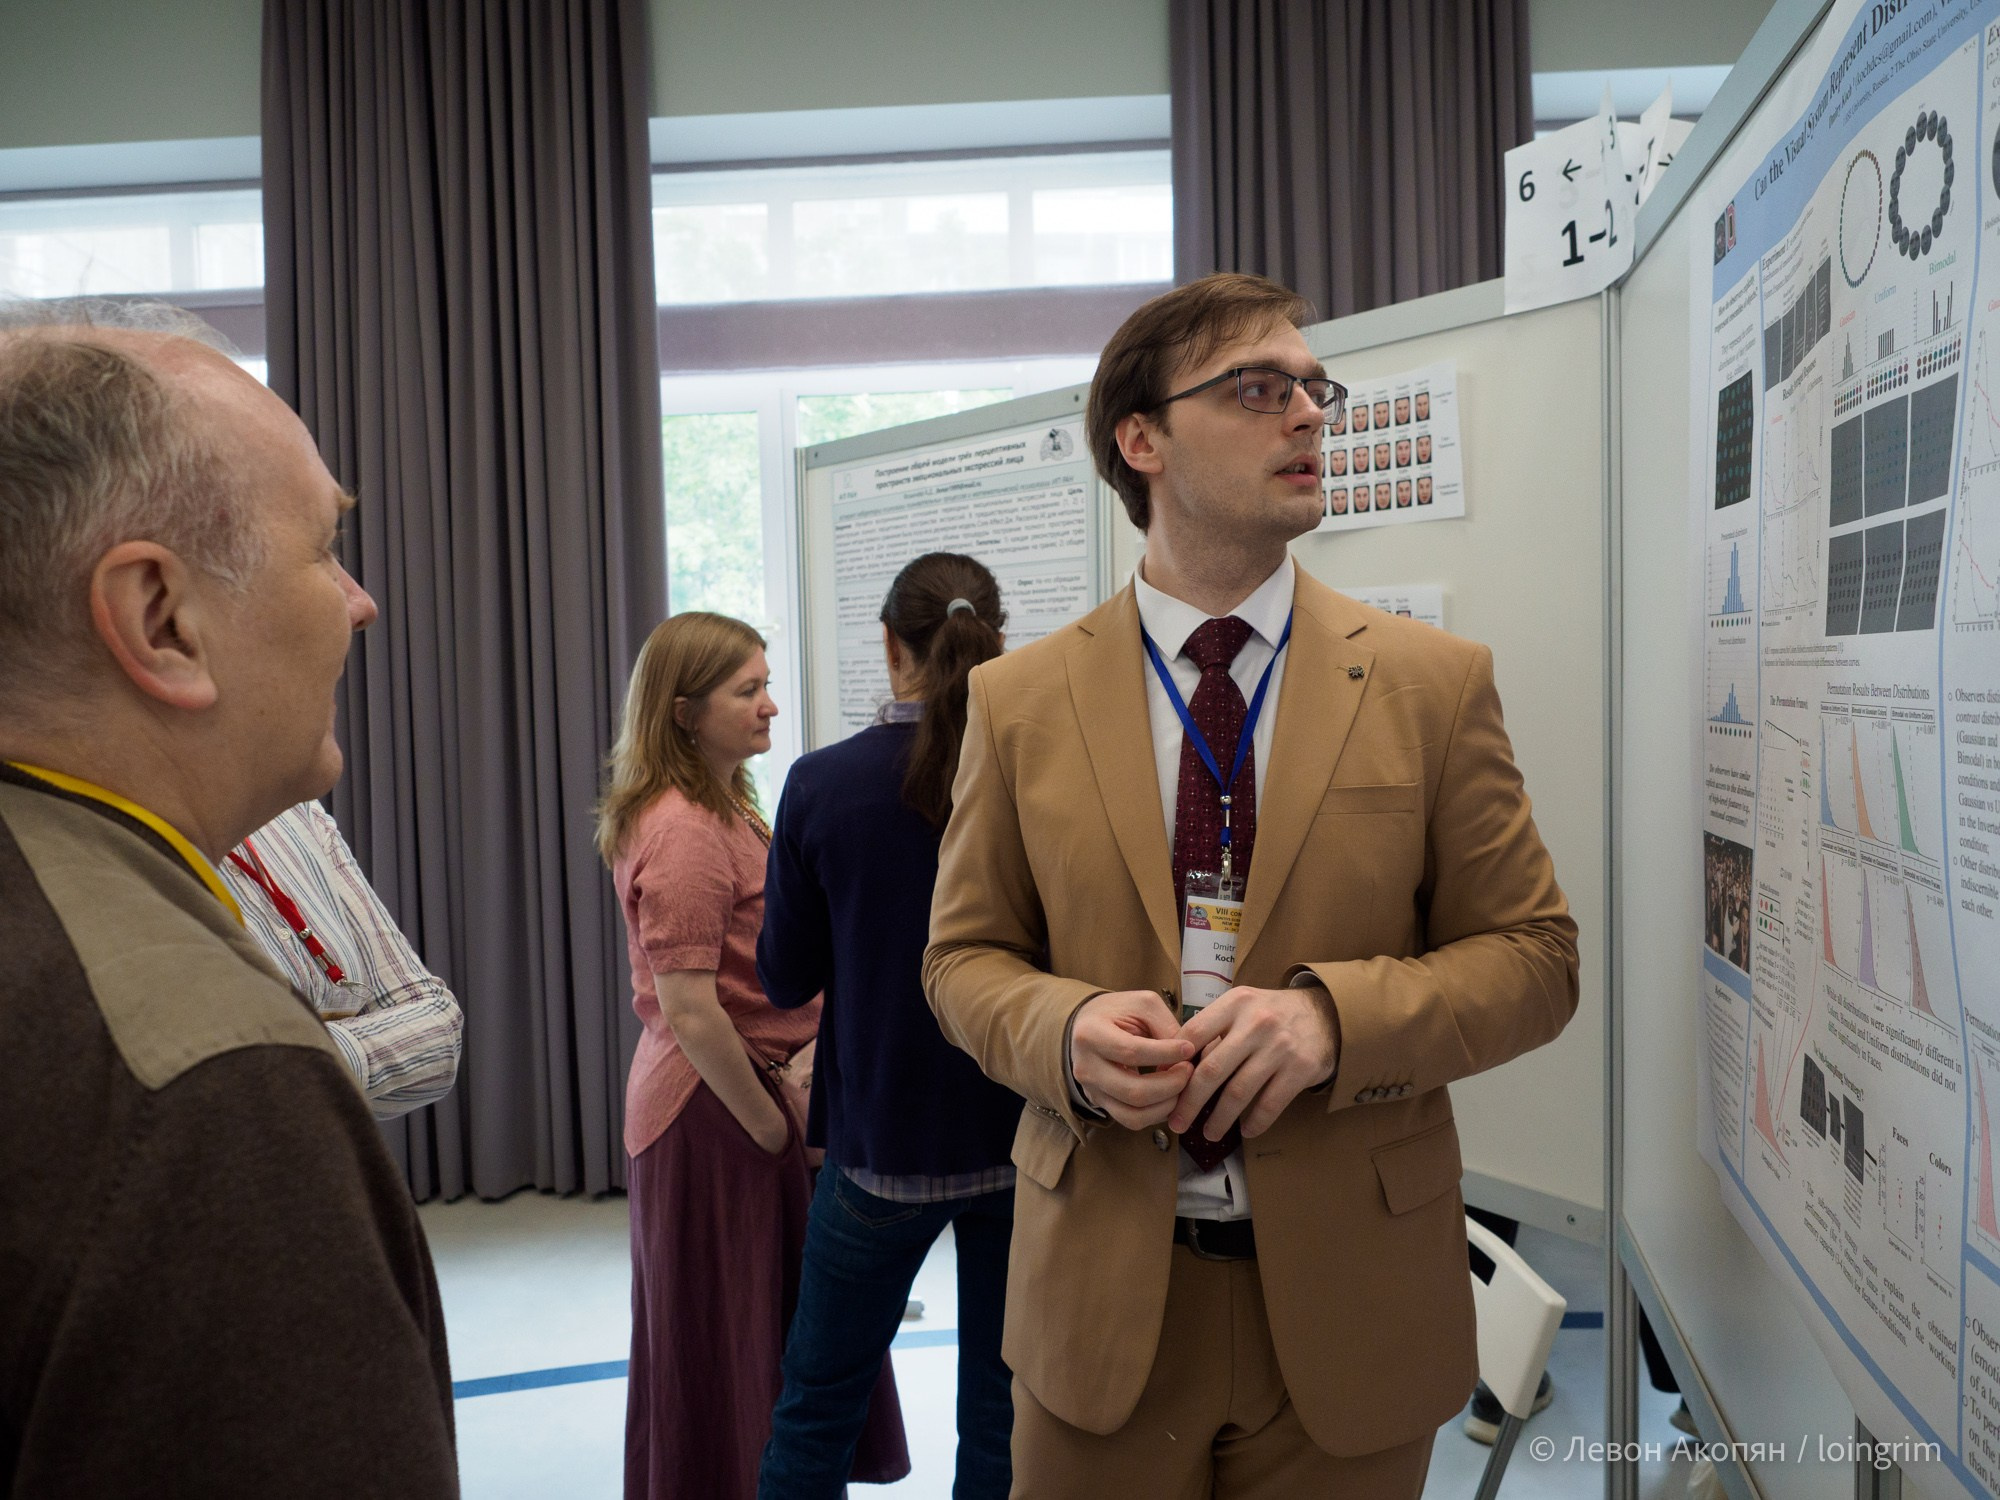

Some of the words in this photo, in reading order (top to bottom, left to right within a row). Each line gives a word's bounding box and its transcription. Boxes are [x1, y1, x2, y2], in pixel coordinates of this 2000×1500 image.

[1906, 44, 1922, 64] Ohio
[1922, 34, 1937, 52] State
[1769, 156, 1784, 184] the
[1784, 128, 1807, 166] Visual
[1806, 92, 1830, 140] System
[1830, 19, 1868, 96] Represent
[1519, 170, 1536, 202] 6
[1561, 199, 1618, 268] 1-2
[1929, 250, 1957, 275] Bimodal
[1874, 285, 1896, 304] Uniform
[875, 463, 909, 477] Построение
[1006, 454, 1024, 465] лица
[1852, 683, 1870, 697] Results
[1871, 684, 1892, 698] Between
[1893, 684, 1930, 700] Distributions
[1955, 688, 1985, 702] Observers
[1921, 712, 1933, 721] Colors
[1956, 713, 1980, 723] contrast
[1957, 730, 1986, 745] (Gaussian
[1988, 734, 1997, 747] and
[1957, 751, 1984, 768] Bimodal)
[1986, 754, 1992, 768] in
[1958, 774, 1988, 789] conditions
[1959, 793, 1985, 810] Gaussian
[1987, 801, 1993, 812] vs
[1960, 813, 1965, 826] in
[1967, 815, 1976, 829] the
[1960, 855, 1977, 871] Other
[1961, 874, 1998, 900] indiscernible
[1962, 899, 1975, 912] each
[1977, 903, 1994, 919] other.
[1213, 942, 1236, 952] Dmitr
[1871, 1017, 1884, 1031] were
[1886, 1023, 1924, 1057] significantly
[1925, 1044, 1954, 1069] different
[1955, 1058, 1962, 1075] in
[1857, 1024, 1866, 1040] and
[1867, 1031, 1889, 1056] Uniform
[1891, 1046, 1930, 1079] distributions
[1932, 1066, 1943, 1086] did
[1944, 1075, 1957, 1093] not
[1867, 1049, 1882, 1072] Faces.
[1892, 1126, 1909, 1147] Faces
[1929, 1152, 1952, 1176] Colors
[1863, 1254, 1878, 1277] cannot
[1883, 1277, 1904, 1303] explain
[1912, 1302, 1920, 1320] the
[1928, 1319, 1957, 1355] obtained
[1861, 1288, 1878, 1314] feature
[1878, 1311, 1908, 1347] conditions.
[1889, 1301, 1911, 1331] exceeds
[1915, 1326, 1924, 1345] the
[1928, 1341, 1956, 1380] working
[1970, 1375, 1980, 1391] of
[1981, 1386, 1986, 1399] a
[1970, 1396, 1981, 1420] To
[1969, 1428, 1979, 1447] on
[1983, 1439, 1995, 1464] the
[1969, 1451, 1987, 1481] than
[1990, 1471, 2000, 1496] ho
